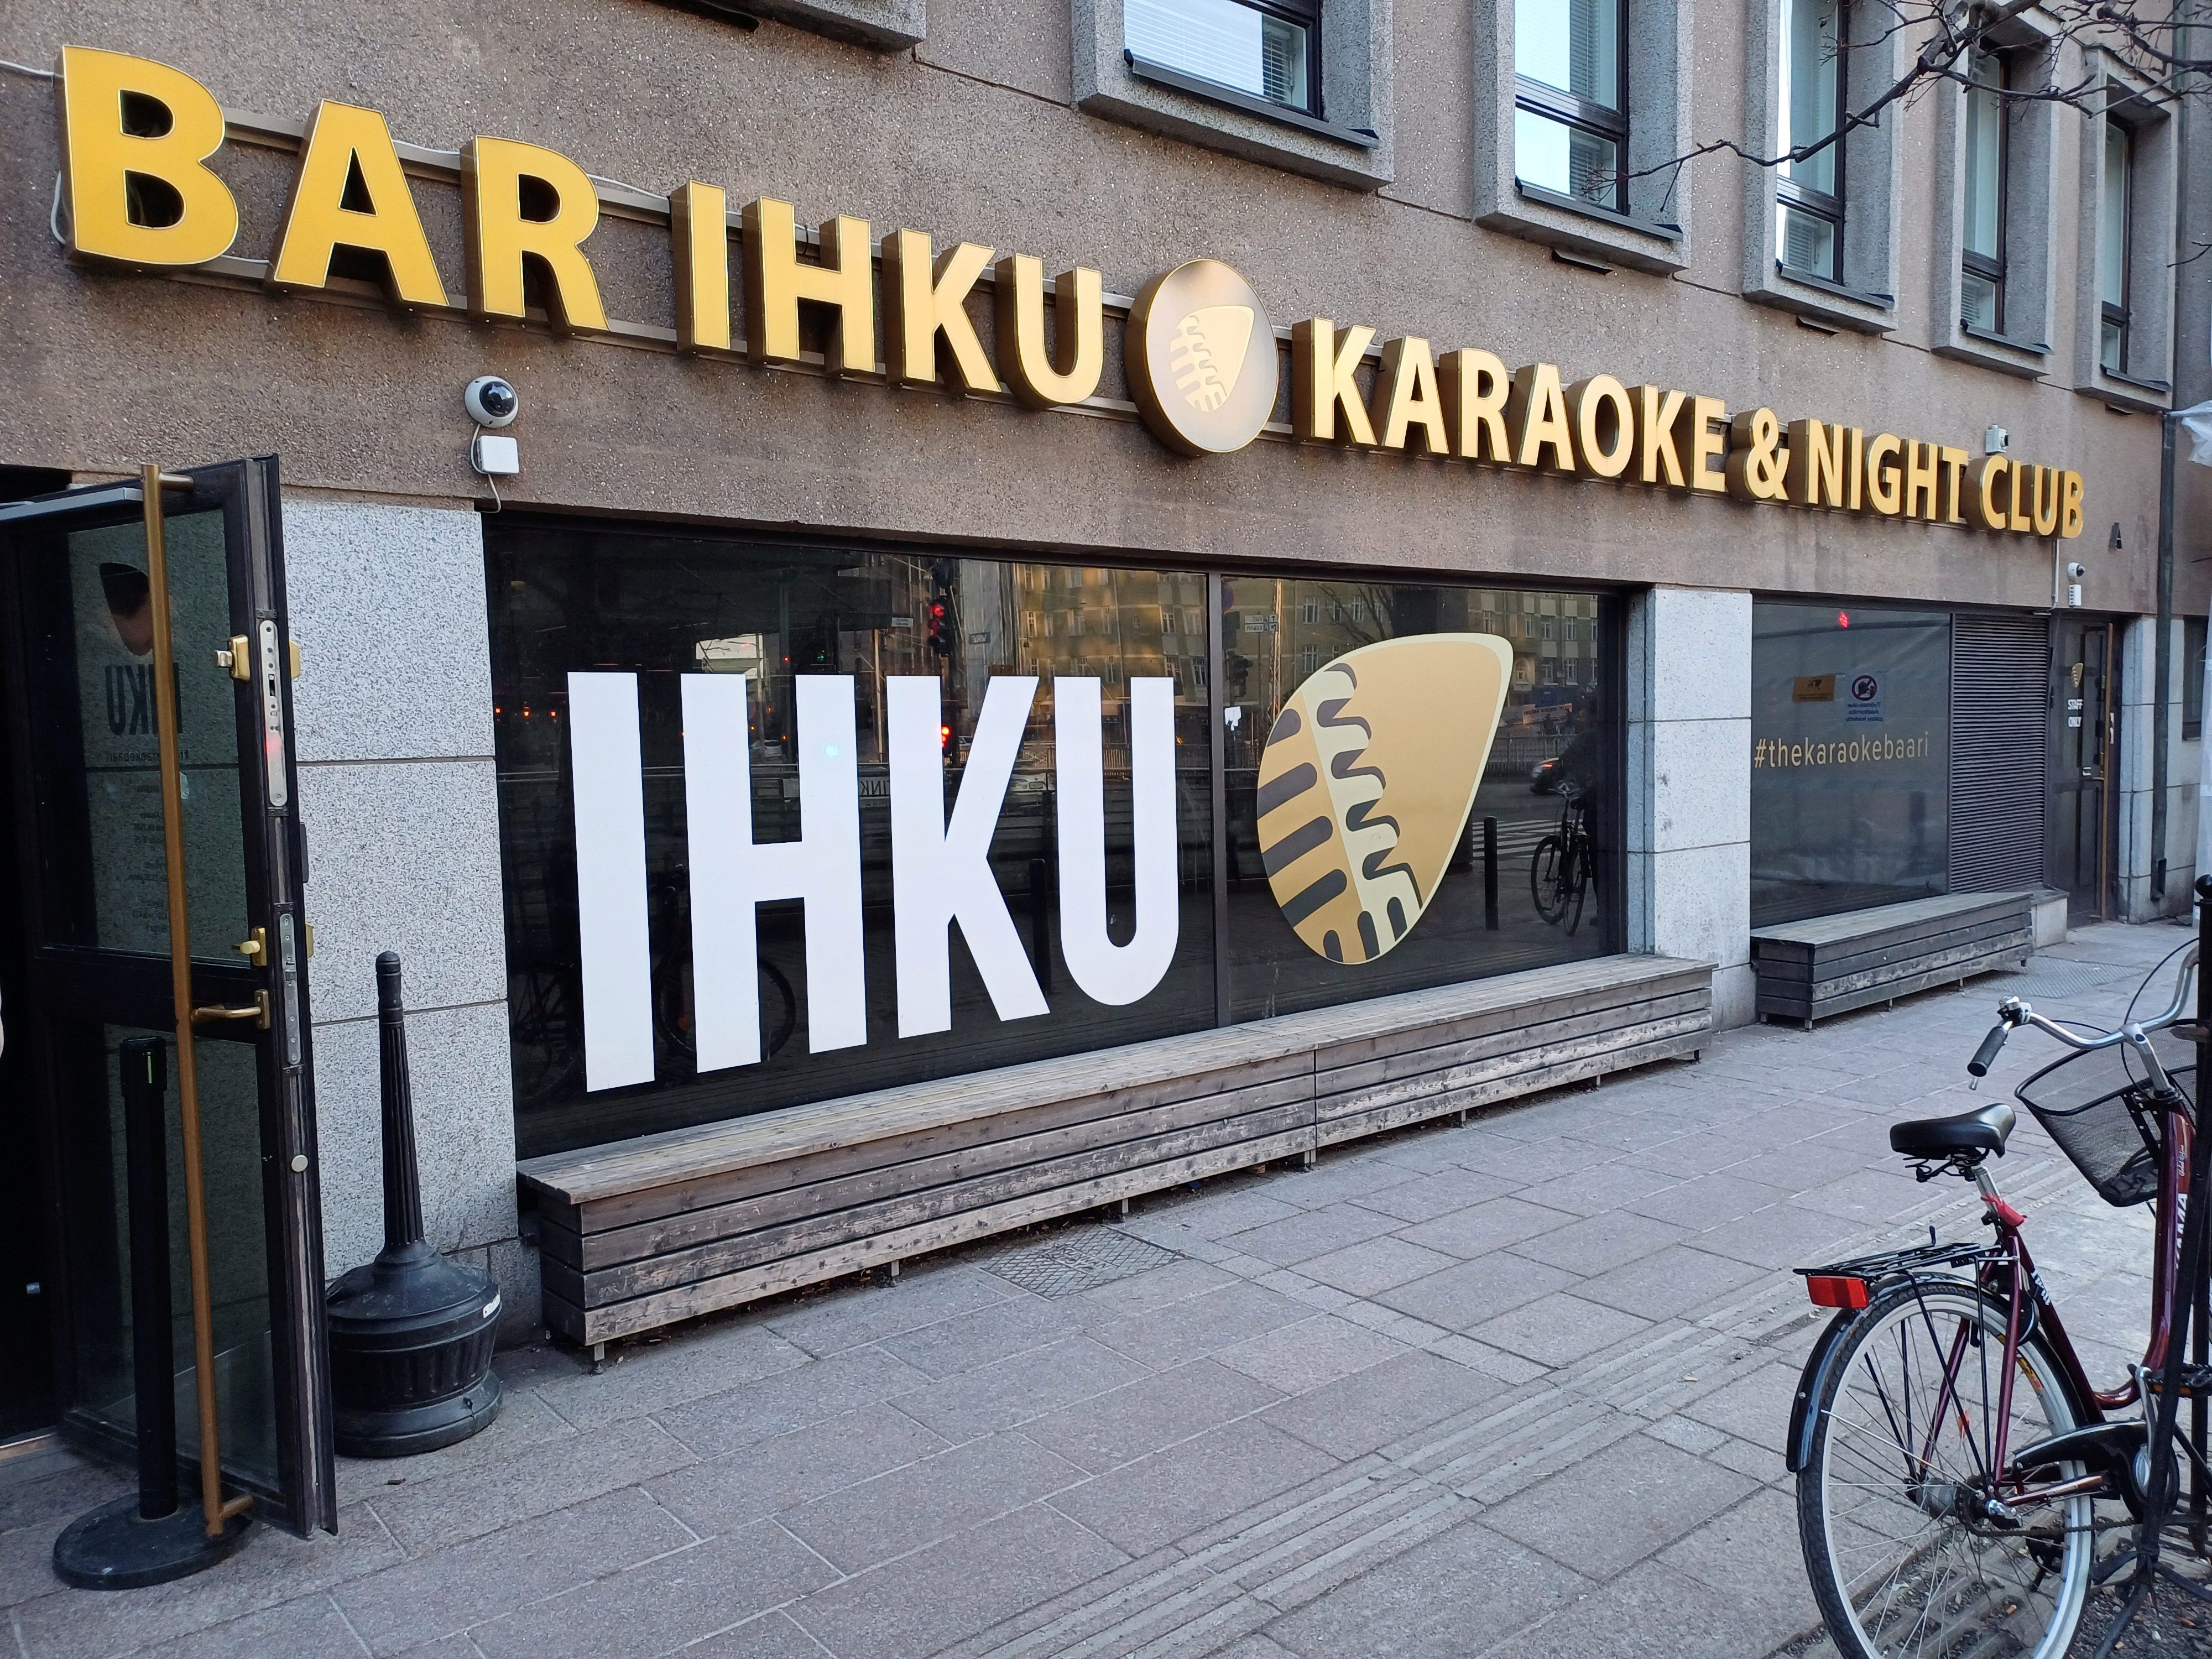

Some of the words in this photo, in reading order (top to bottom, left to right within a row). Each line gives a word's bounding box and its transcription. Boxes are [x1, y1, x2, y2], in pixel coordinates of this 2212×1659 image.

[59, 45, 610, 331] BAR
[686, 179, 1104, 405] IHKU
[1311, 316, 1726, 493] KARAOKE
[1744, 406, 1790, 500] &
[1804, 418, 1969, 523] NIGHT
[1979, 455, 2085, 539] CLUB
[567, 671, 1180, 1093] IHKU
[1754, 737, 1928, 768] #thekaraokebaari
